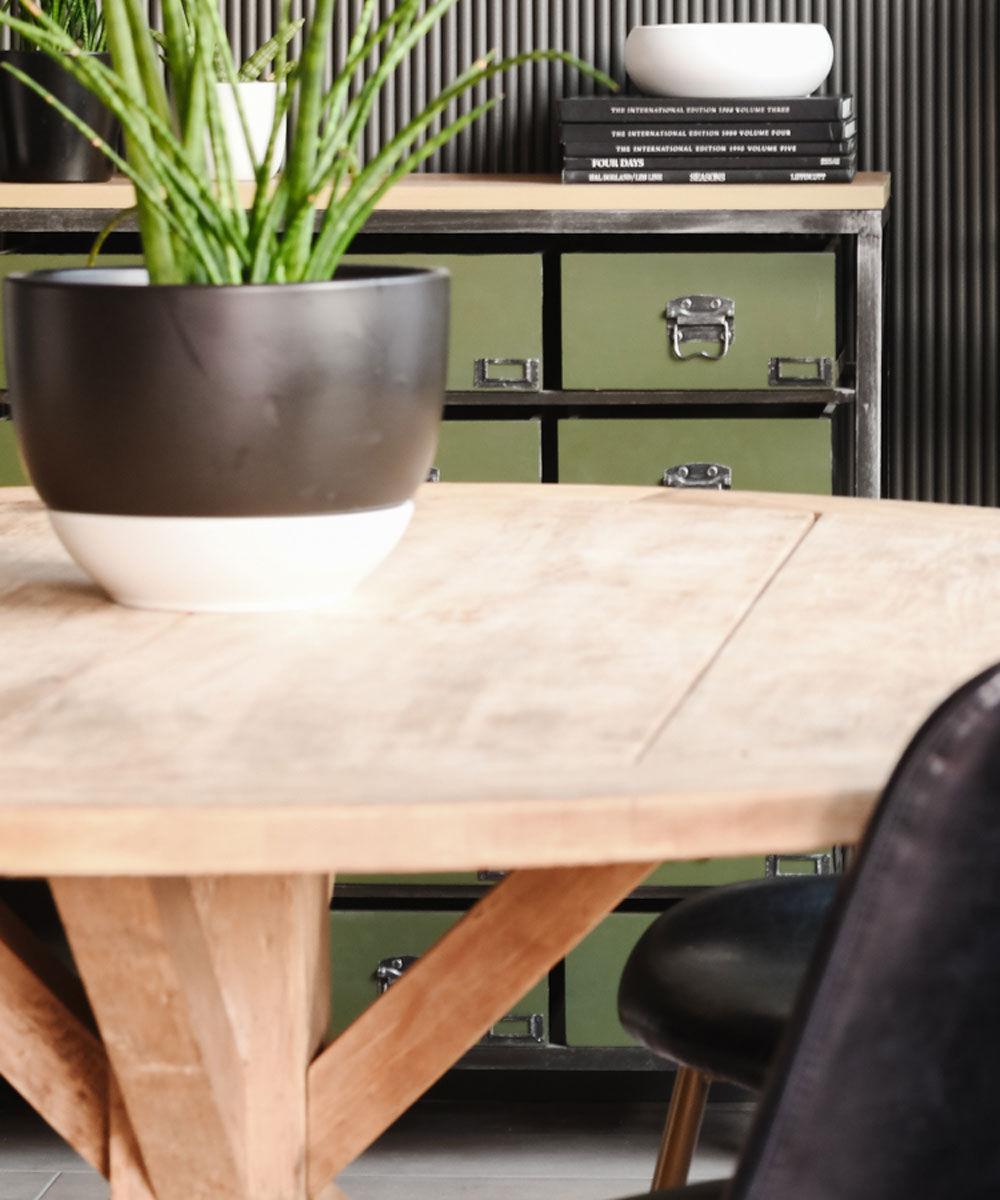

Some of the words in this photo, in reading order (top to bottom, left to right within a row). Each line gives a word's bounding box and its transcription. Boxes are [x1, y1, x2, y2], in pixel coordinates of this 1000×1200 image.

[735, 106, 765, 114] VOLUME
[611, 130, 625, 138] THE
[739, 129, 769, 137] VOLUME
[616, 145, 631, 153] THE
[633, 145, 693, 153] INTERNATIONAL
[695, 145, 726, 153] EDITION
[747, 145, 777, 153] VOLUME
[780, 145, 797, 153] FIVE
[591, 157, 619, 168] FOUR
[620, 157, 645, 168] DAYS
[689, 172, 726, 182] SEASONS
